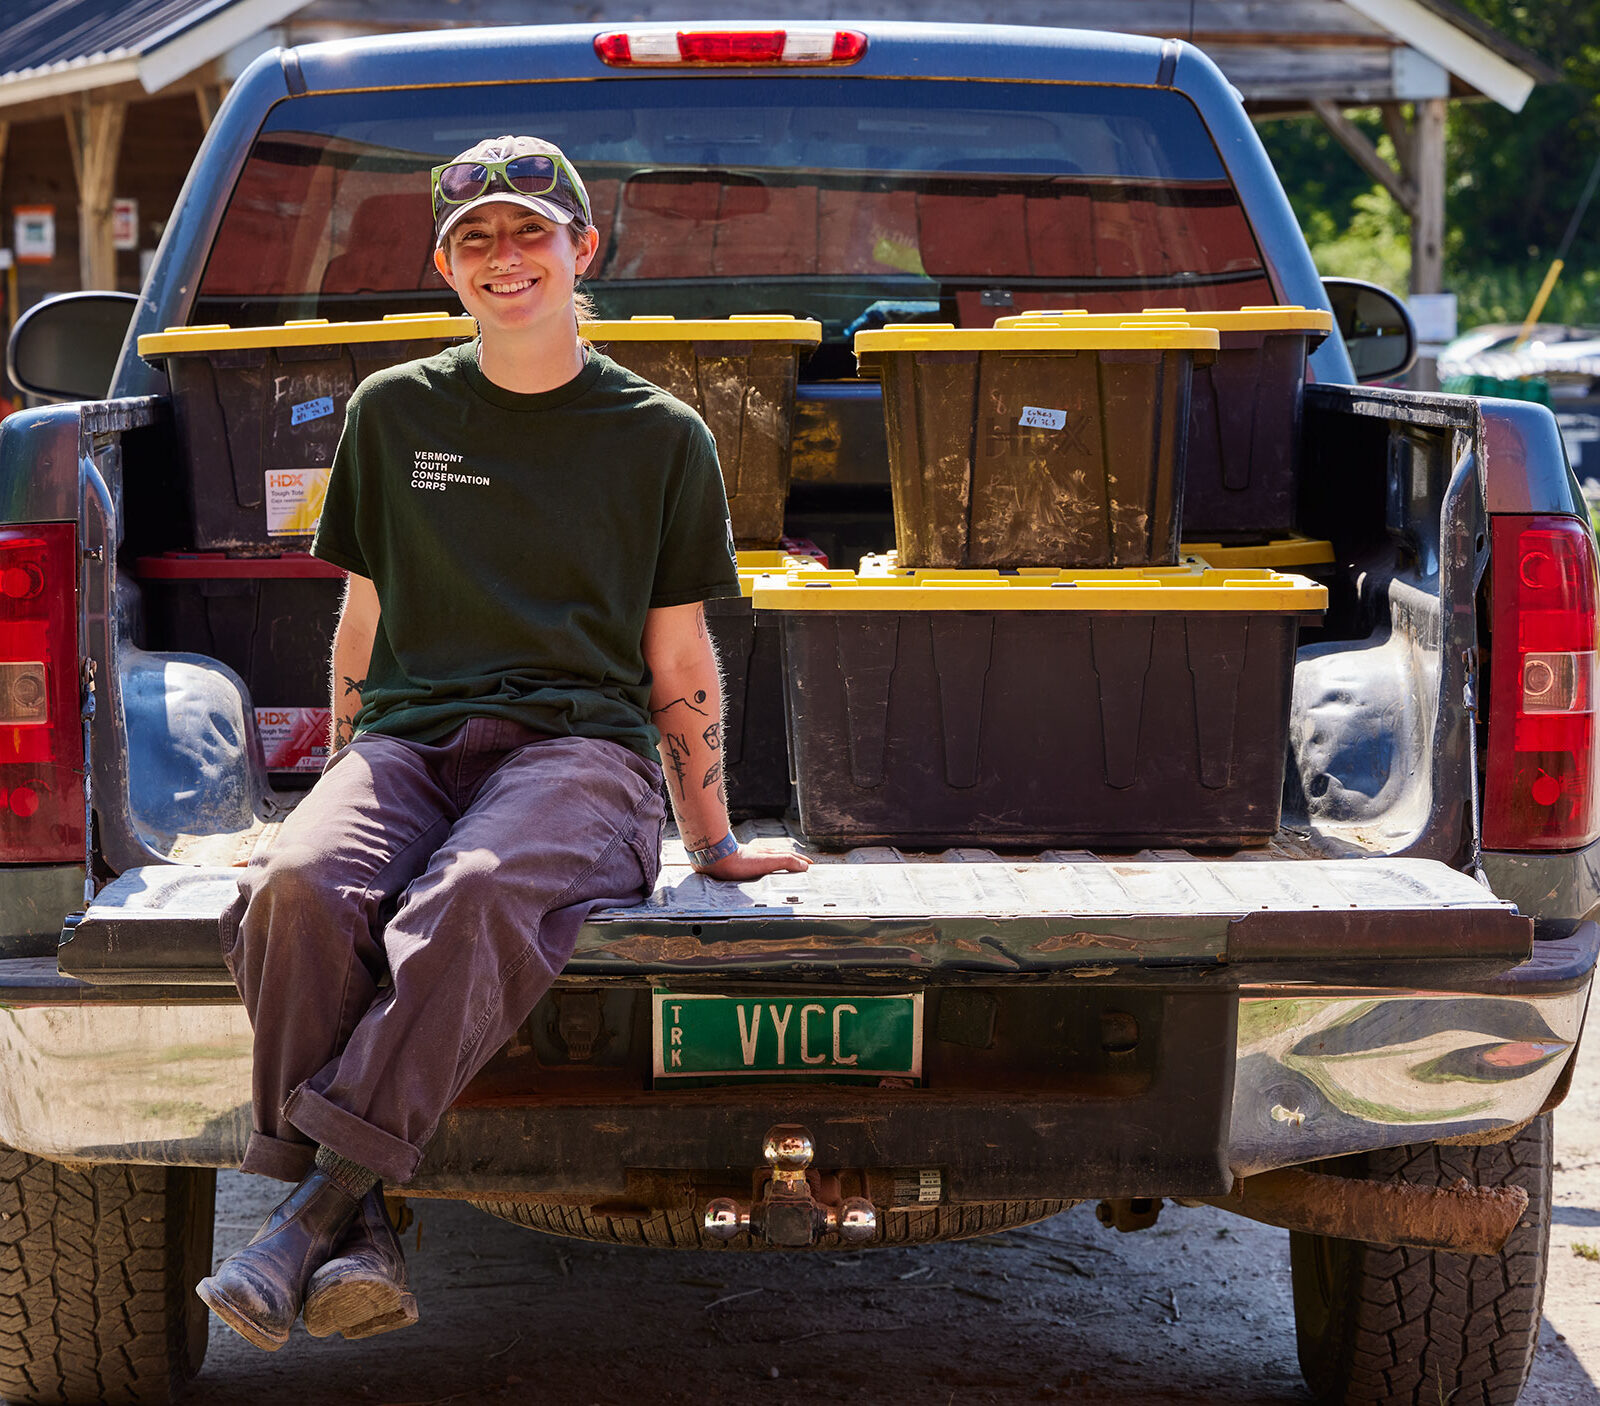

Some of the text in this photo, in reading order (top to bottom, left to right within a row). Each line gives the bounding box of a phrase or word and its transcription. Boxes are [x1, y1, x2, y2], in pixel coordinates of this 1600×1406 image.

[414, 451, 463, 463] VERMONT
[413, 461, 448, 471] YOUTH
[270, 474, 304, 488] HDX
[411, 470, 490, 486] CONSERVATION
[410, 480, 446, 491] CORPS
[257, 712, 291, 725] HDX
[670, 1005, 683, 1067] TRK
[736, 1003, 859, 1066] VYCC
